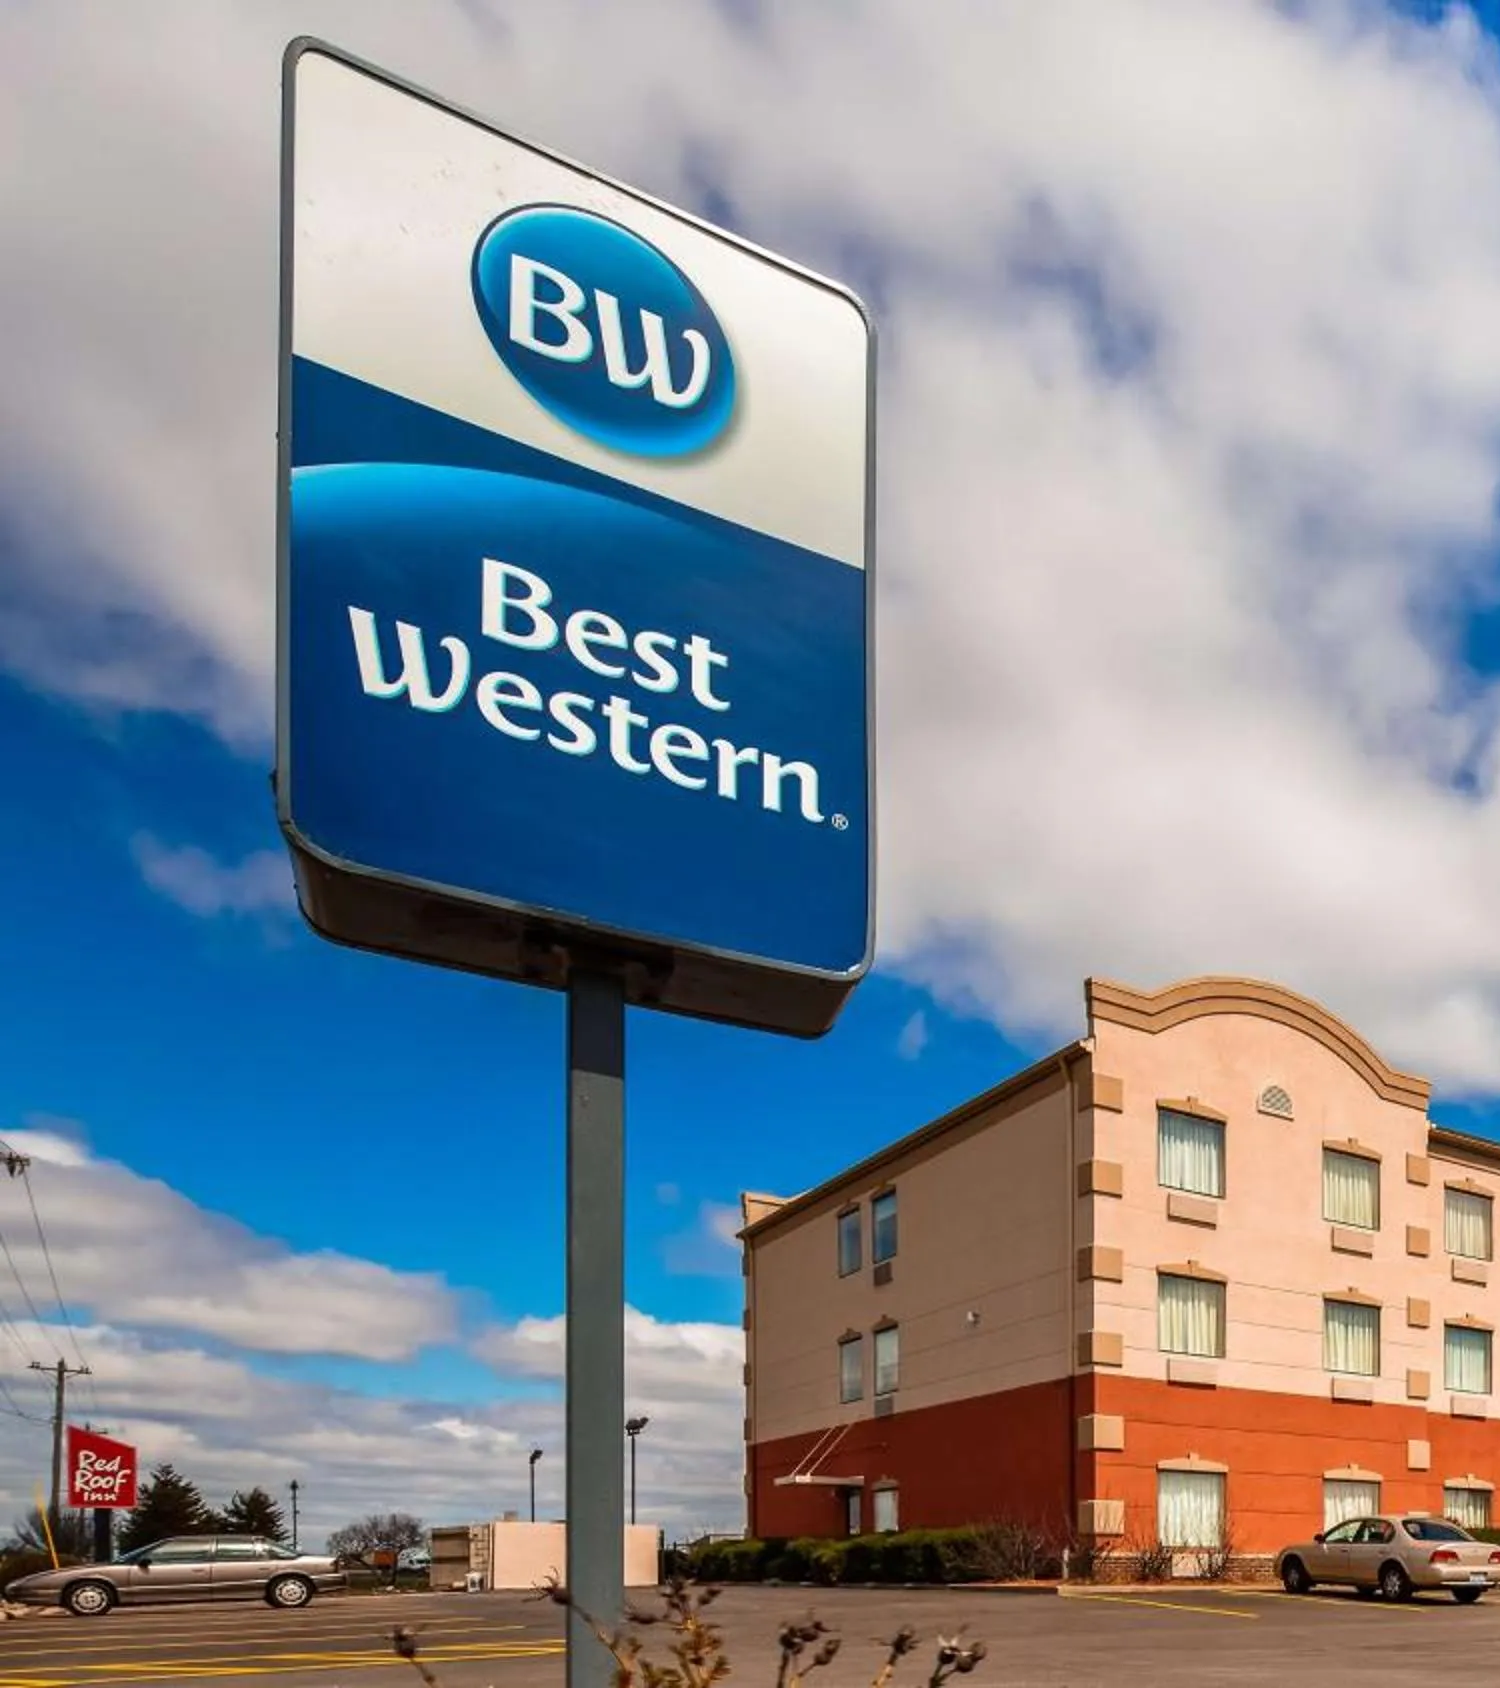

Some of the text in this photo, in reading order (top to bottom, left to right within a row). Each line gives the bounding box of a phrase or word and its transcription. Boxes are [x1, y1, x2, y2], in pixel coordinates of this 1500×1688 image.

[509, 253, 711, 408] BW
[481, 557, 731, 711] Best
[75, 1469, 131, 1492] Roof
[79, 1450, 121, 1471] Red
